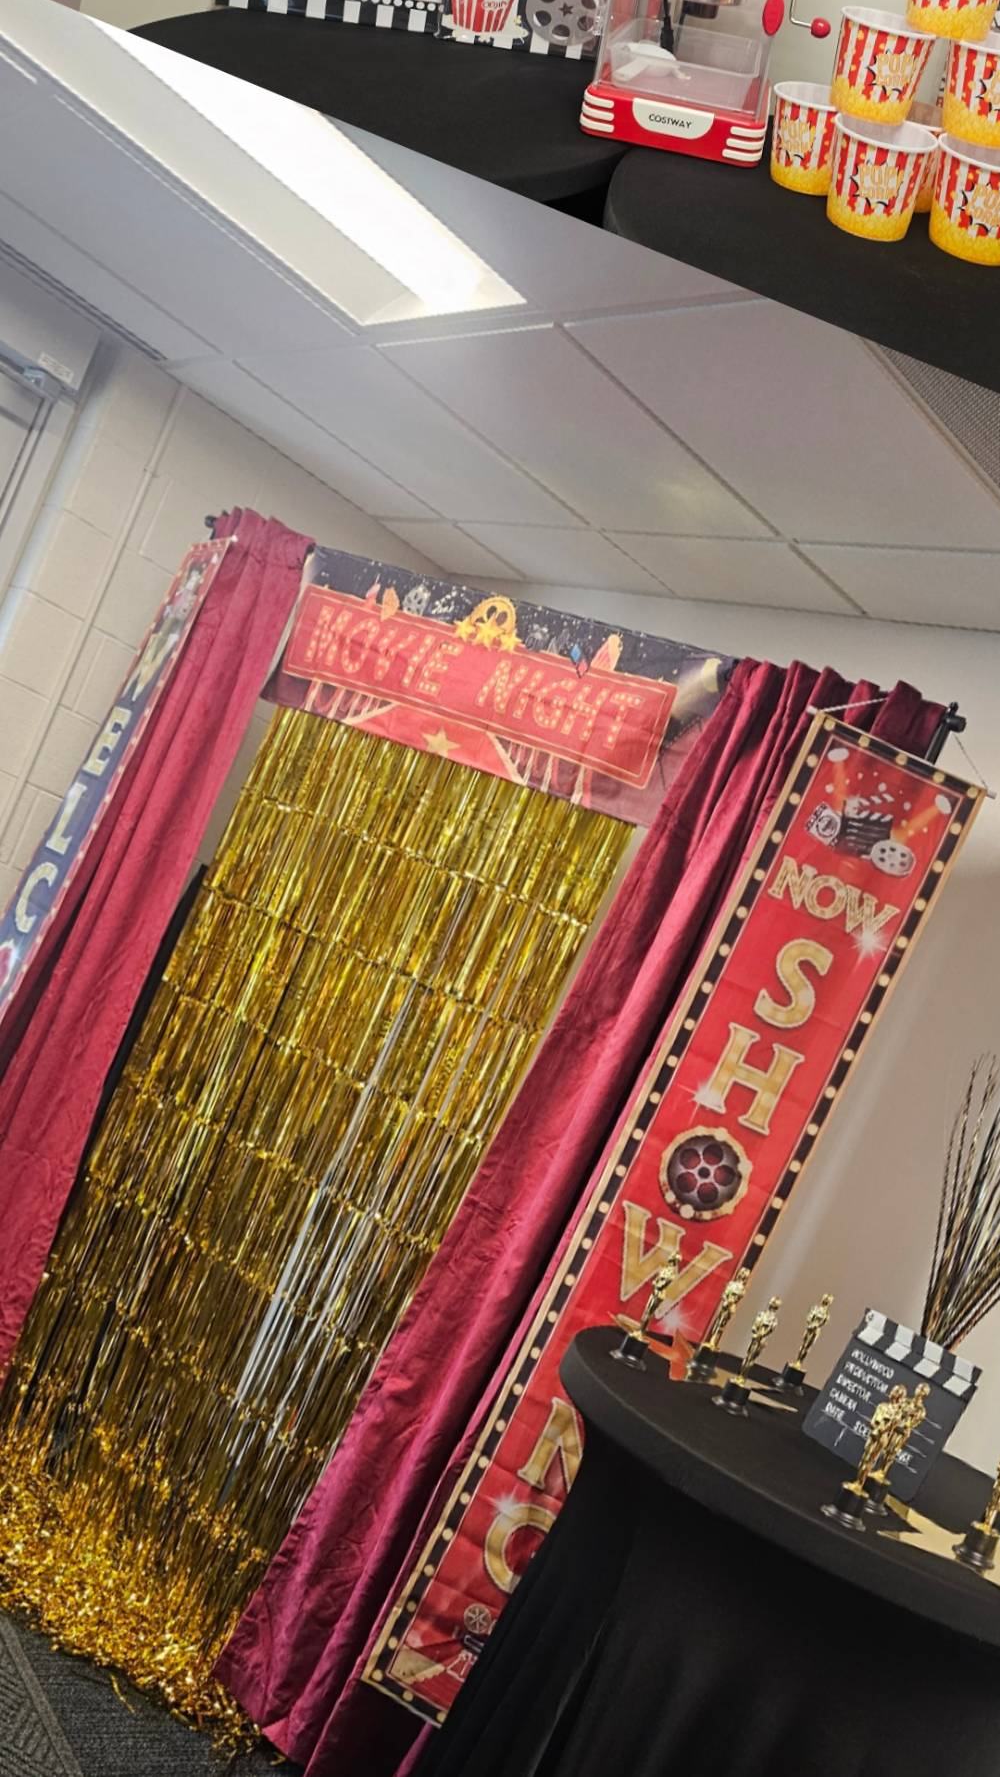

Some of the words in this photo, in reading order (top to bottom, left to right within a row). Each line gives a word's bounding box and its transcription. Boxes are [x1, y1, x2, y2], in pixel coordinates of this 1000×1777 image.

[648, 113, 692, 129] COSTWAY
[301, 605, 462, 698] MOVIE
[477, 655, 647, 751] NIGHT
[765, 856, 902, 939] NOW
